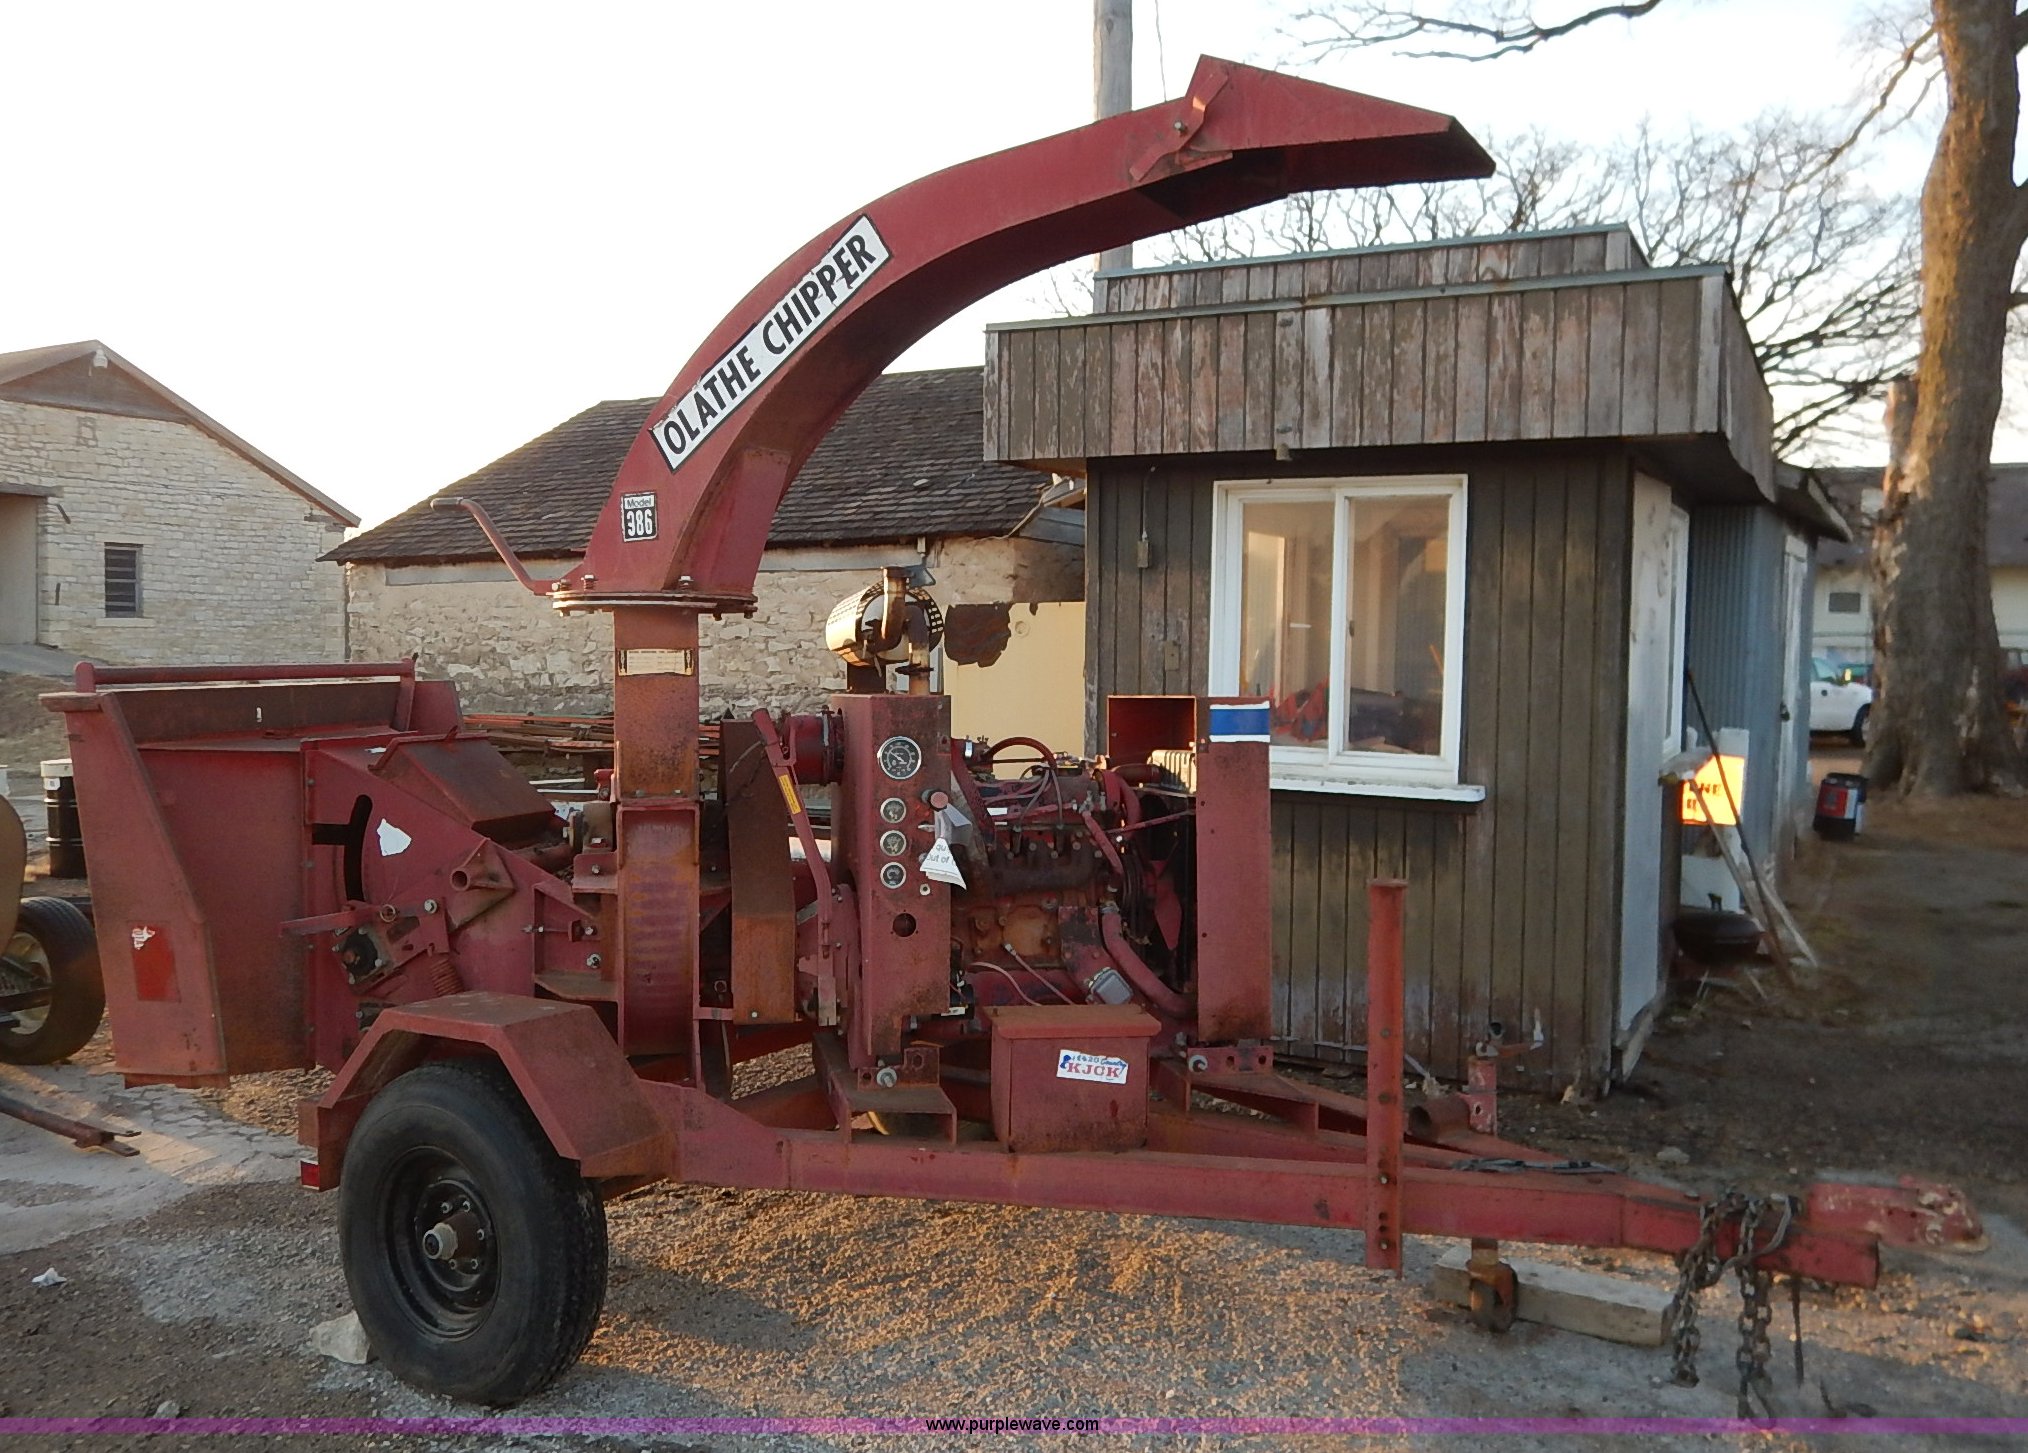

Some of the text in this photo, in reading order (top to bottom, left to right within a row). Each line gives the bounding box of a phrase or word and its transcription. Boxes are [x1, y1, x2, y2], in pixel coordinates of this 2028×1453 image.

[663, 234, 877, 455] OLATHE CHIPPER
[626, 498, 652, 508] Model
[626, 509, 653, 536] 386
